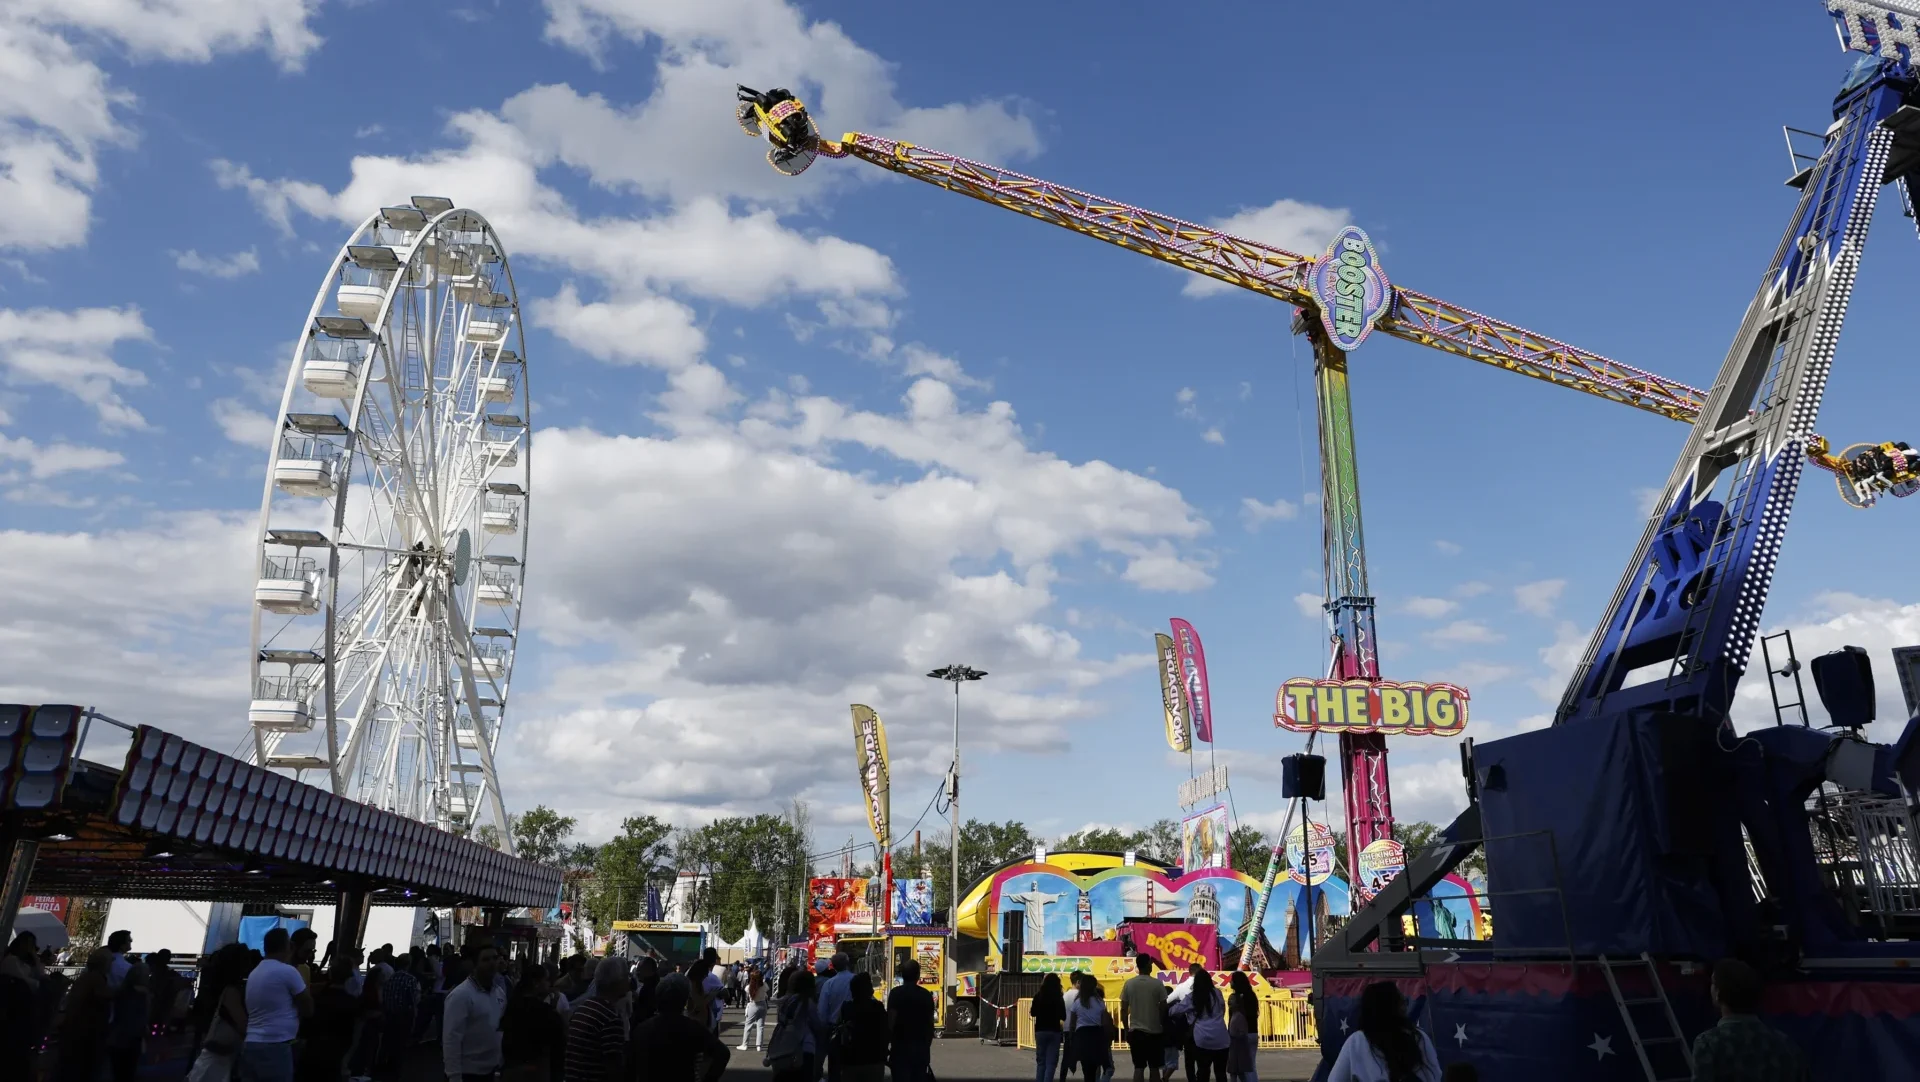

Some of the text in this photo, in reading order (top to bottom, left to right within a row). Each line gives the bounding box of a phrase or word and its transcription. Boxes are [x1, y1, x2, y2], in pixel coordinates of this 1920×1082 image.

[1827, 0, 1920, 66] TH
[1335, 237, 1366, 338] BOOSTER
[1286, 686, 1459, 728] THE BIG
[1361, 849, 1394, 861] THE KING
[1251, 889, 1271, 938] ADRENALINA
[1263, 867, 1277, 888] PURA
[1022, 958, 1137, 974] OSTER 4.5
[1146, 932, 1207, 967] BOOSTER
